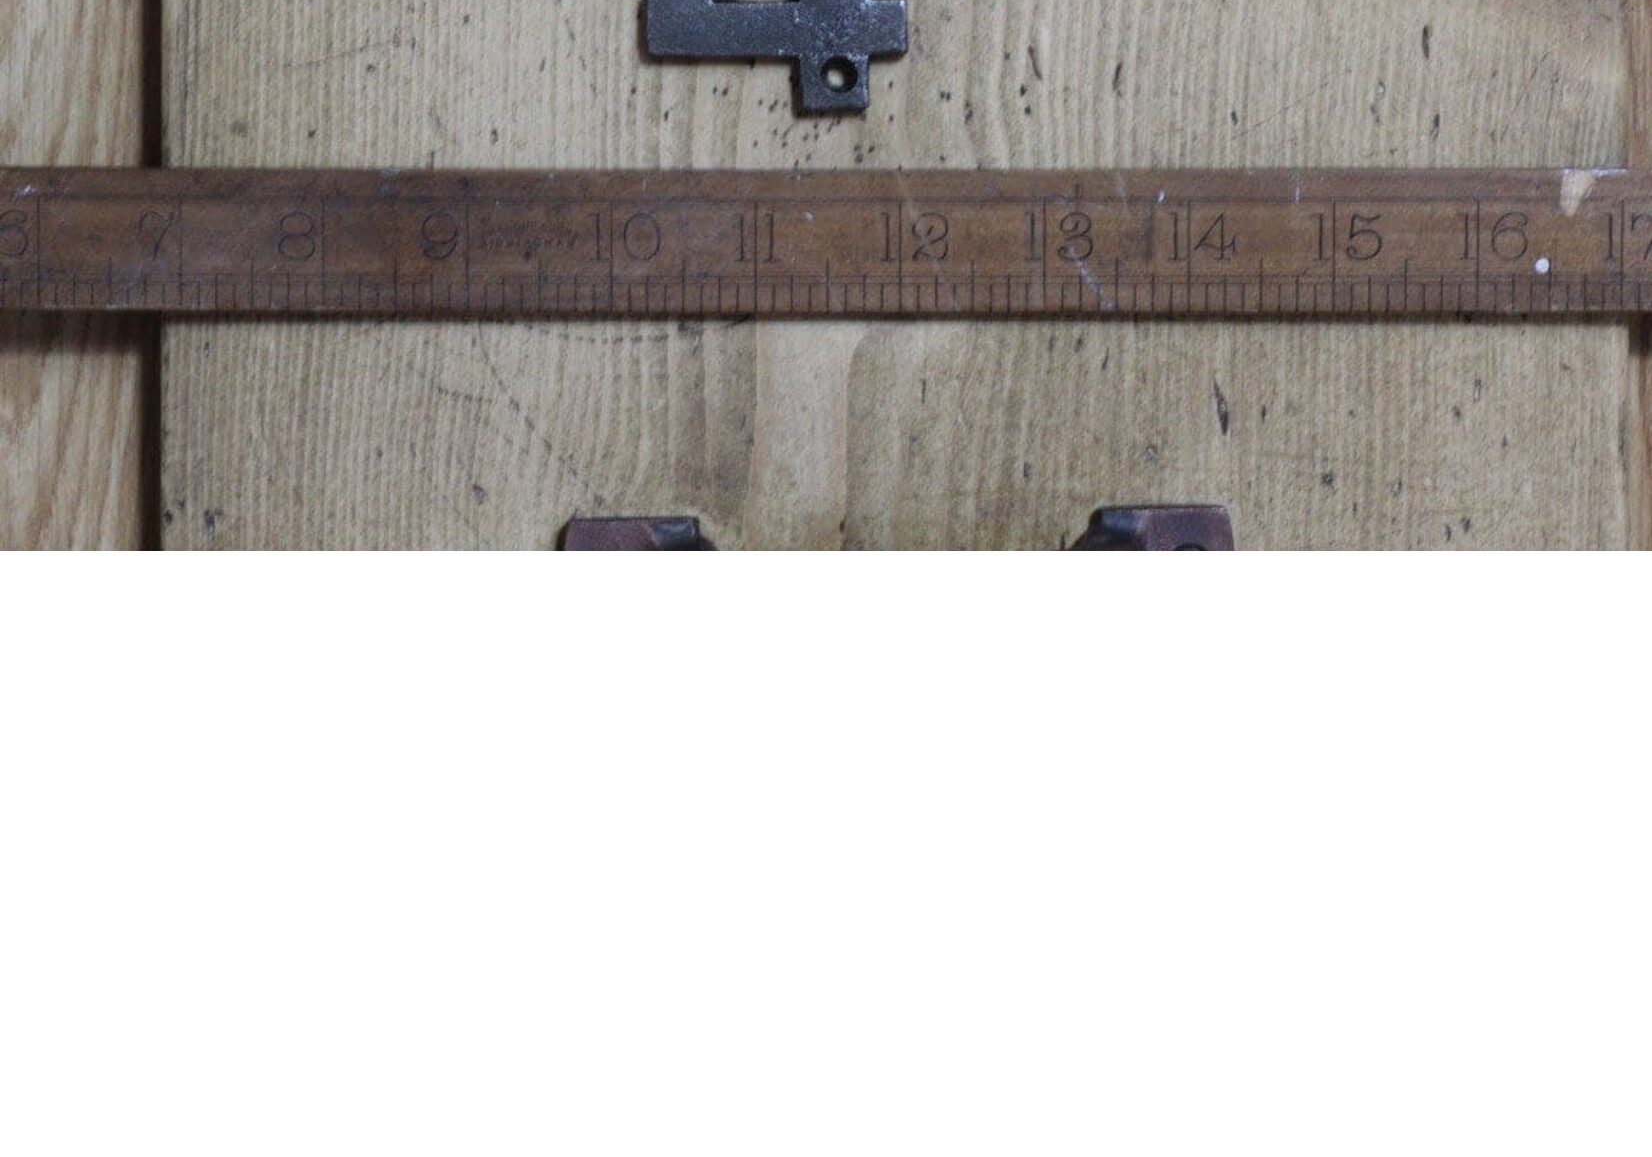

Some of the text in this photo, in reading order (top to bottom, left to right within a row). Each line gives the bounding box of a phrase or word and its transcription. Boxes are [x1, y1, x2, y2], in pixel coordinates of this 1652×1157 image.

[0, 209, 29, 257] 6
[139, 210, 174, 264] 7
[278, 211, 316, 261] 8
[422, 210, 458, 260] 9
[588, 211, 661, 262] 10
[734, 210, 782, 263] 11
[881, 211, 949, 263] 12
[1024, 211, 1094, 262] 13
[1165, 211, 1236, 262] 14
[1310, 211, 1383, 261] 15
[1460, 211, 1529, 261] 16
